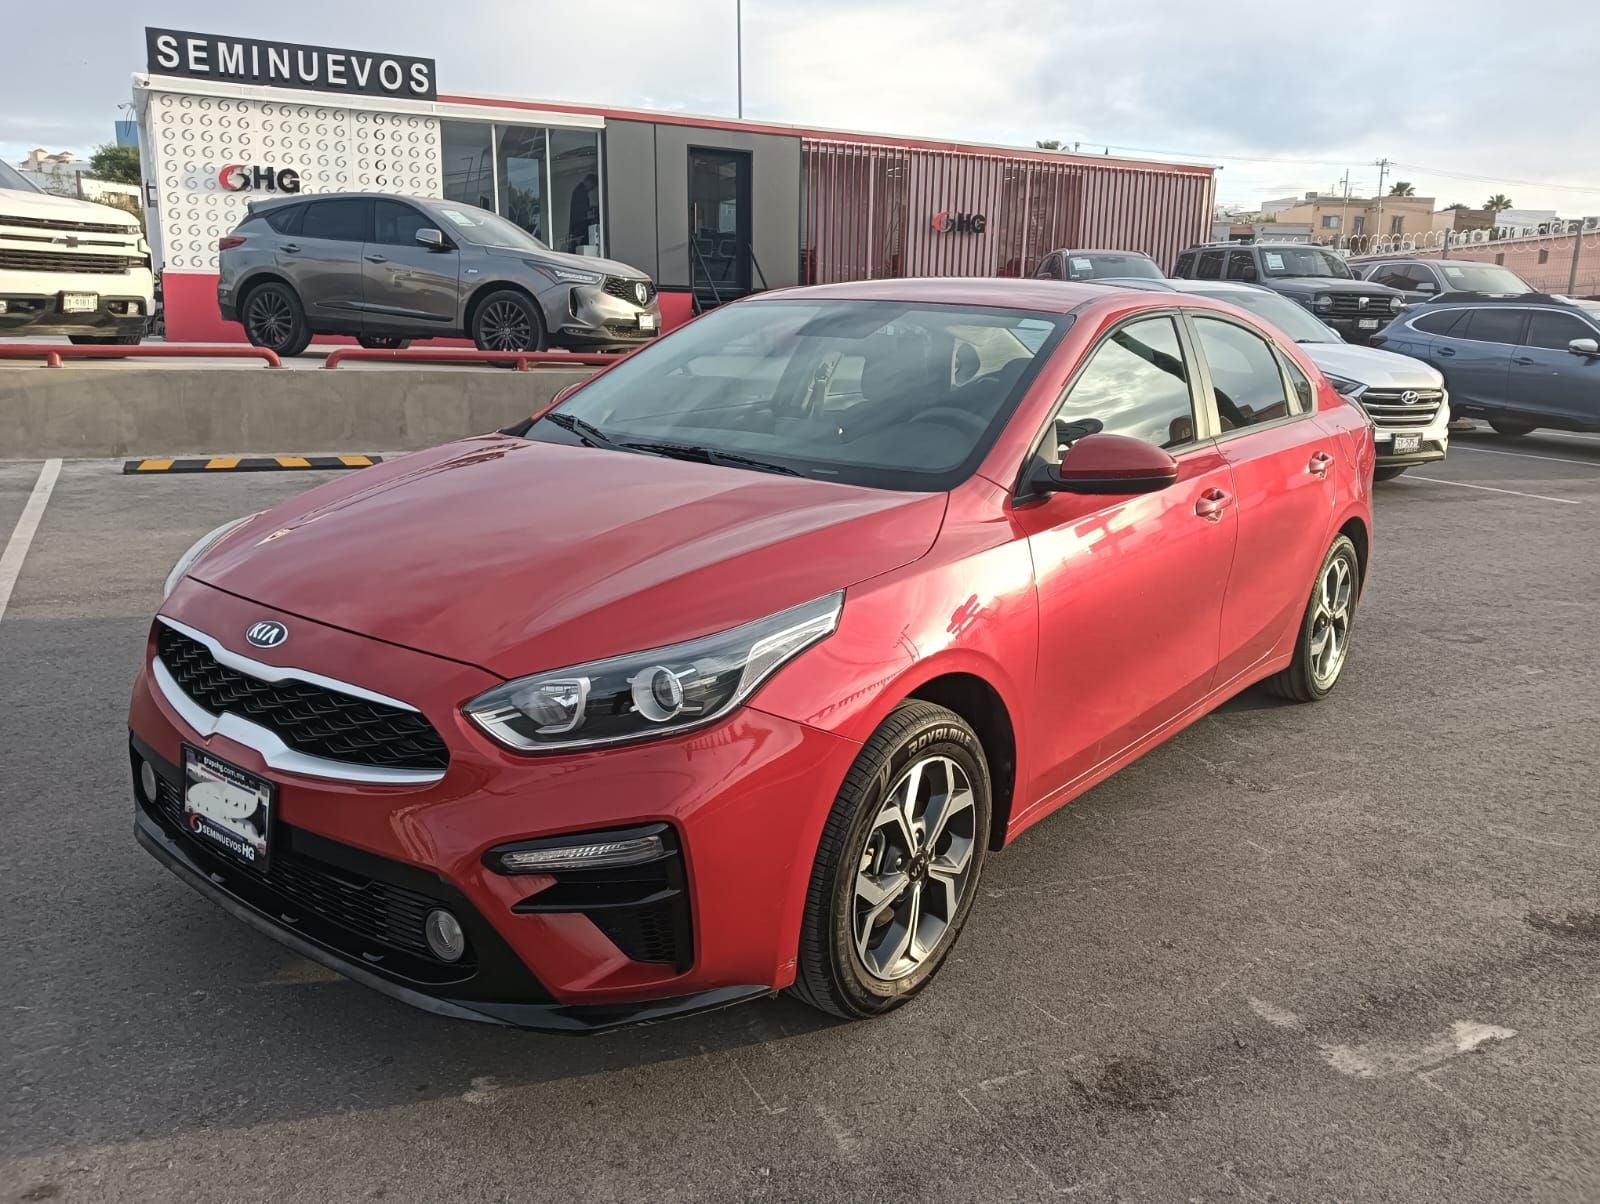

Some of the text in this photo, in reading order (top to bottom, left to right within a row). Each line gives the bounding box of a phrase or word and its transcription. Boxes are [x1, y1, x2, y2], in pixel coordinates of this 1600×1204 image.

[156, 34, 430, 94] SEMINUEVOS
[248, 622, 280, 645] KIA
[202, 824, 256, 862] SEMINUEVOS HG
